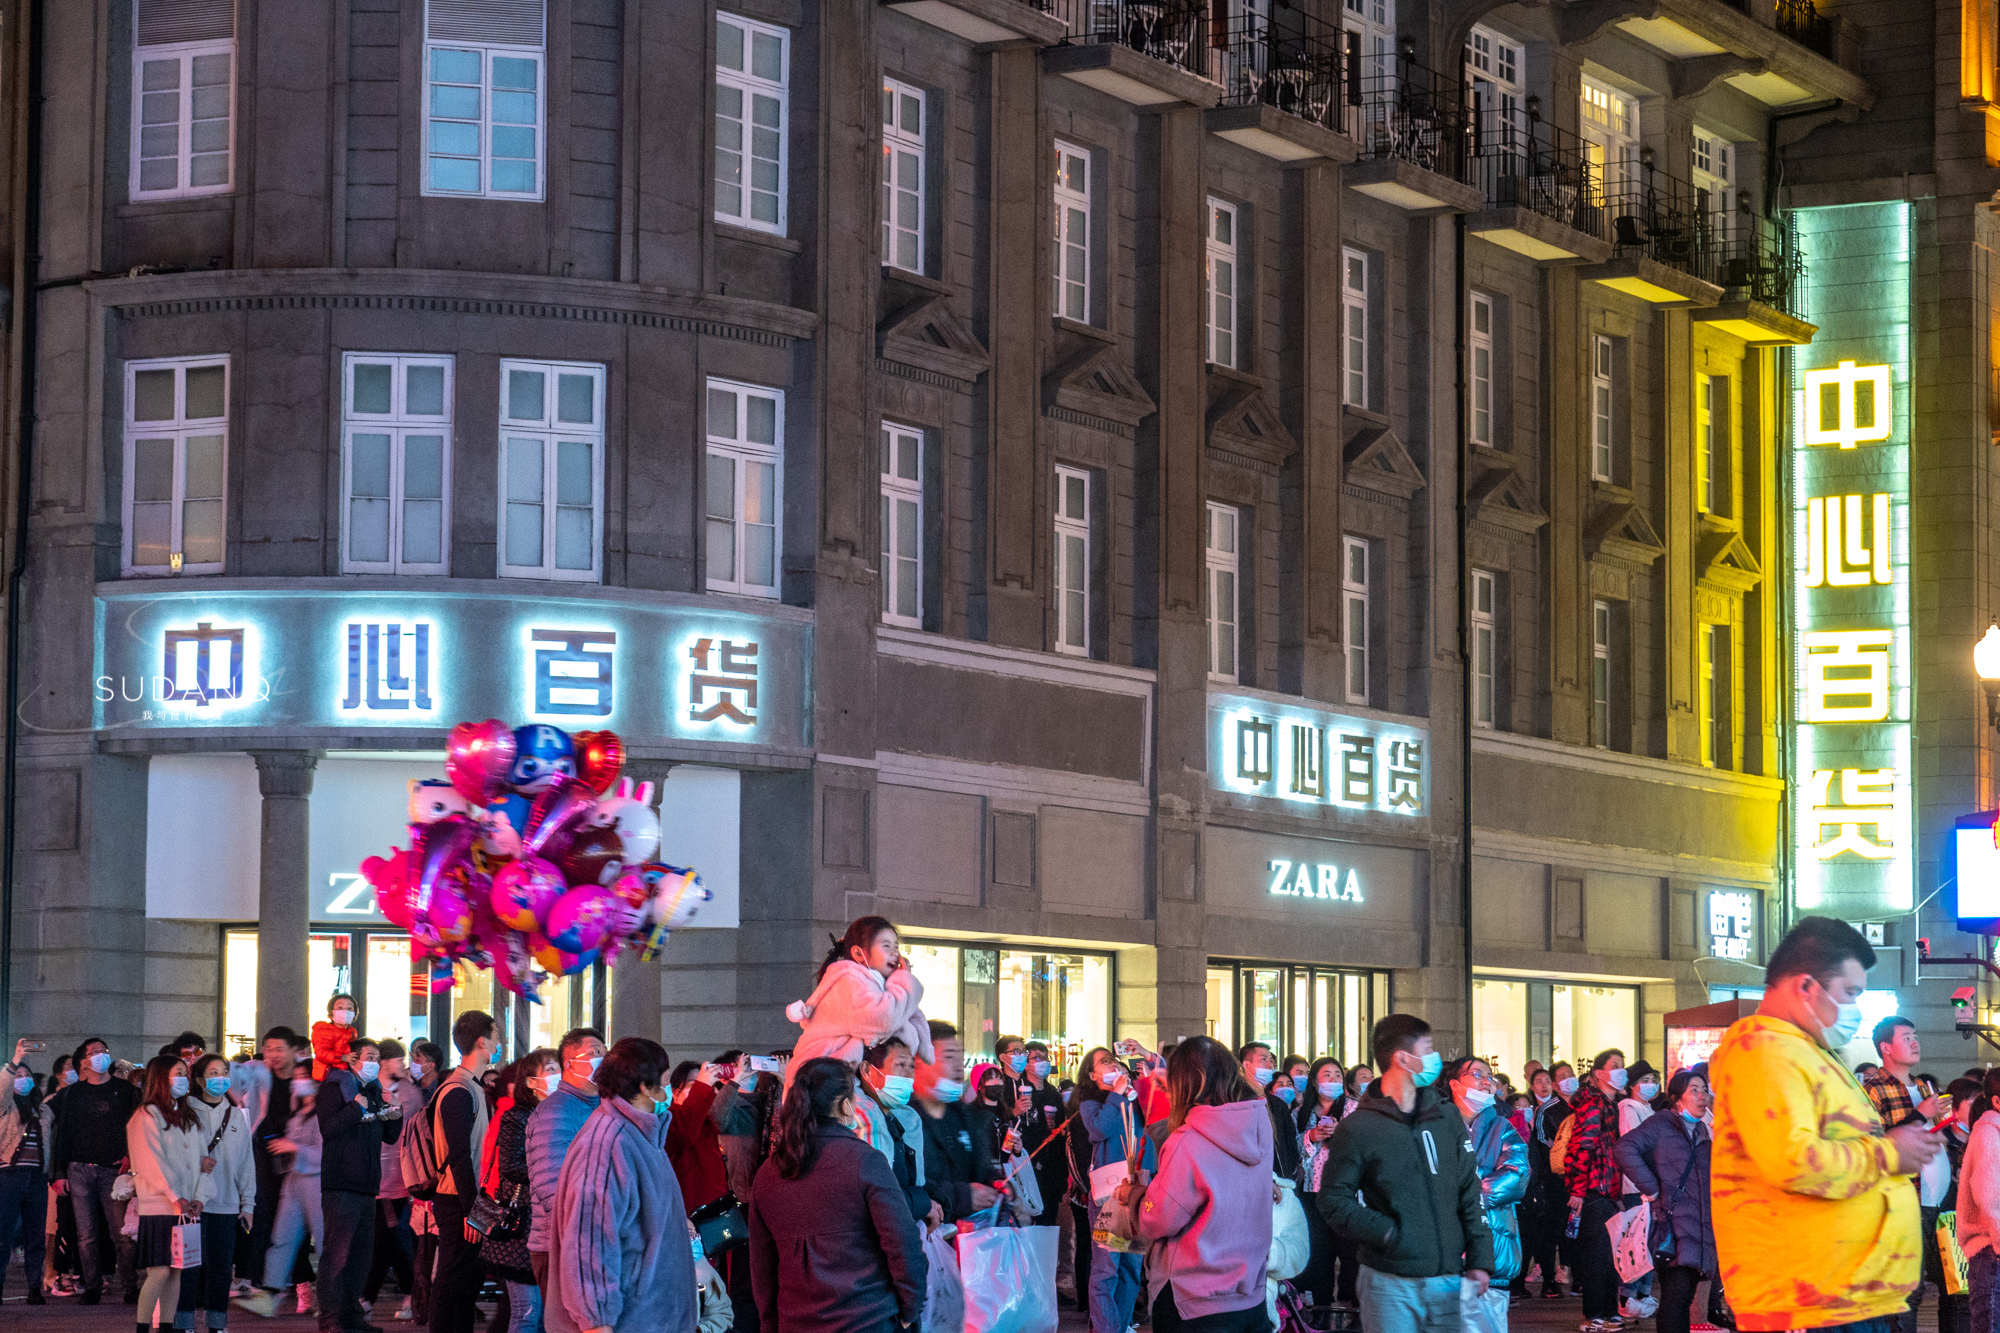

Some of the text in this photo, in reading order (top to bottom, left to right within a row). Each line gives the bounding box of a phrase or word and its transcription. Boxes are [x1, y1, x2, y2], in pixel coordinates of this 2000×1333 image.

[1803, 360, 1893, 860] 中心百货
[165, 622, 758, 725] 中心百货
[535, 726, 564, 750] A
[1237, 717, 1421, 810] 中心百货
[1269, 860, 1364, 902] ZARA
